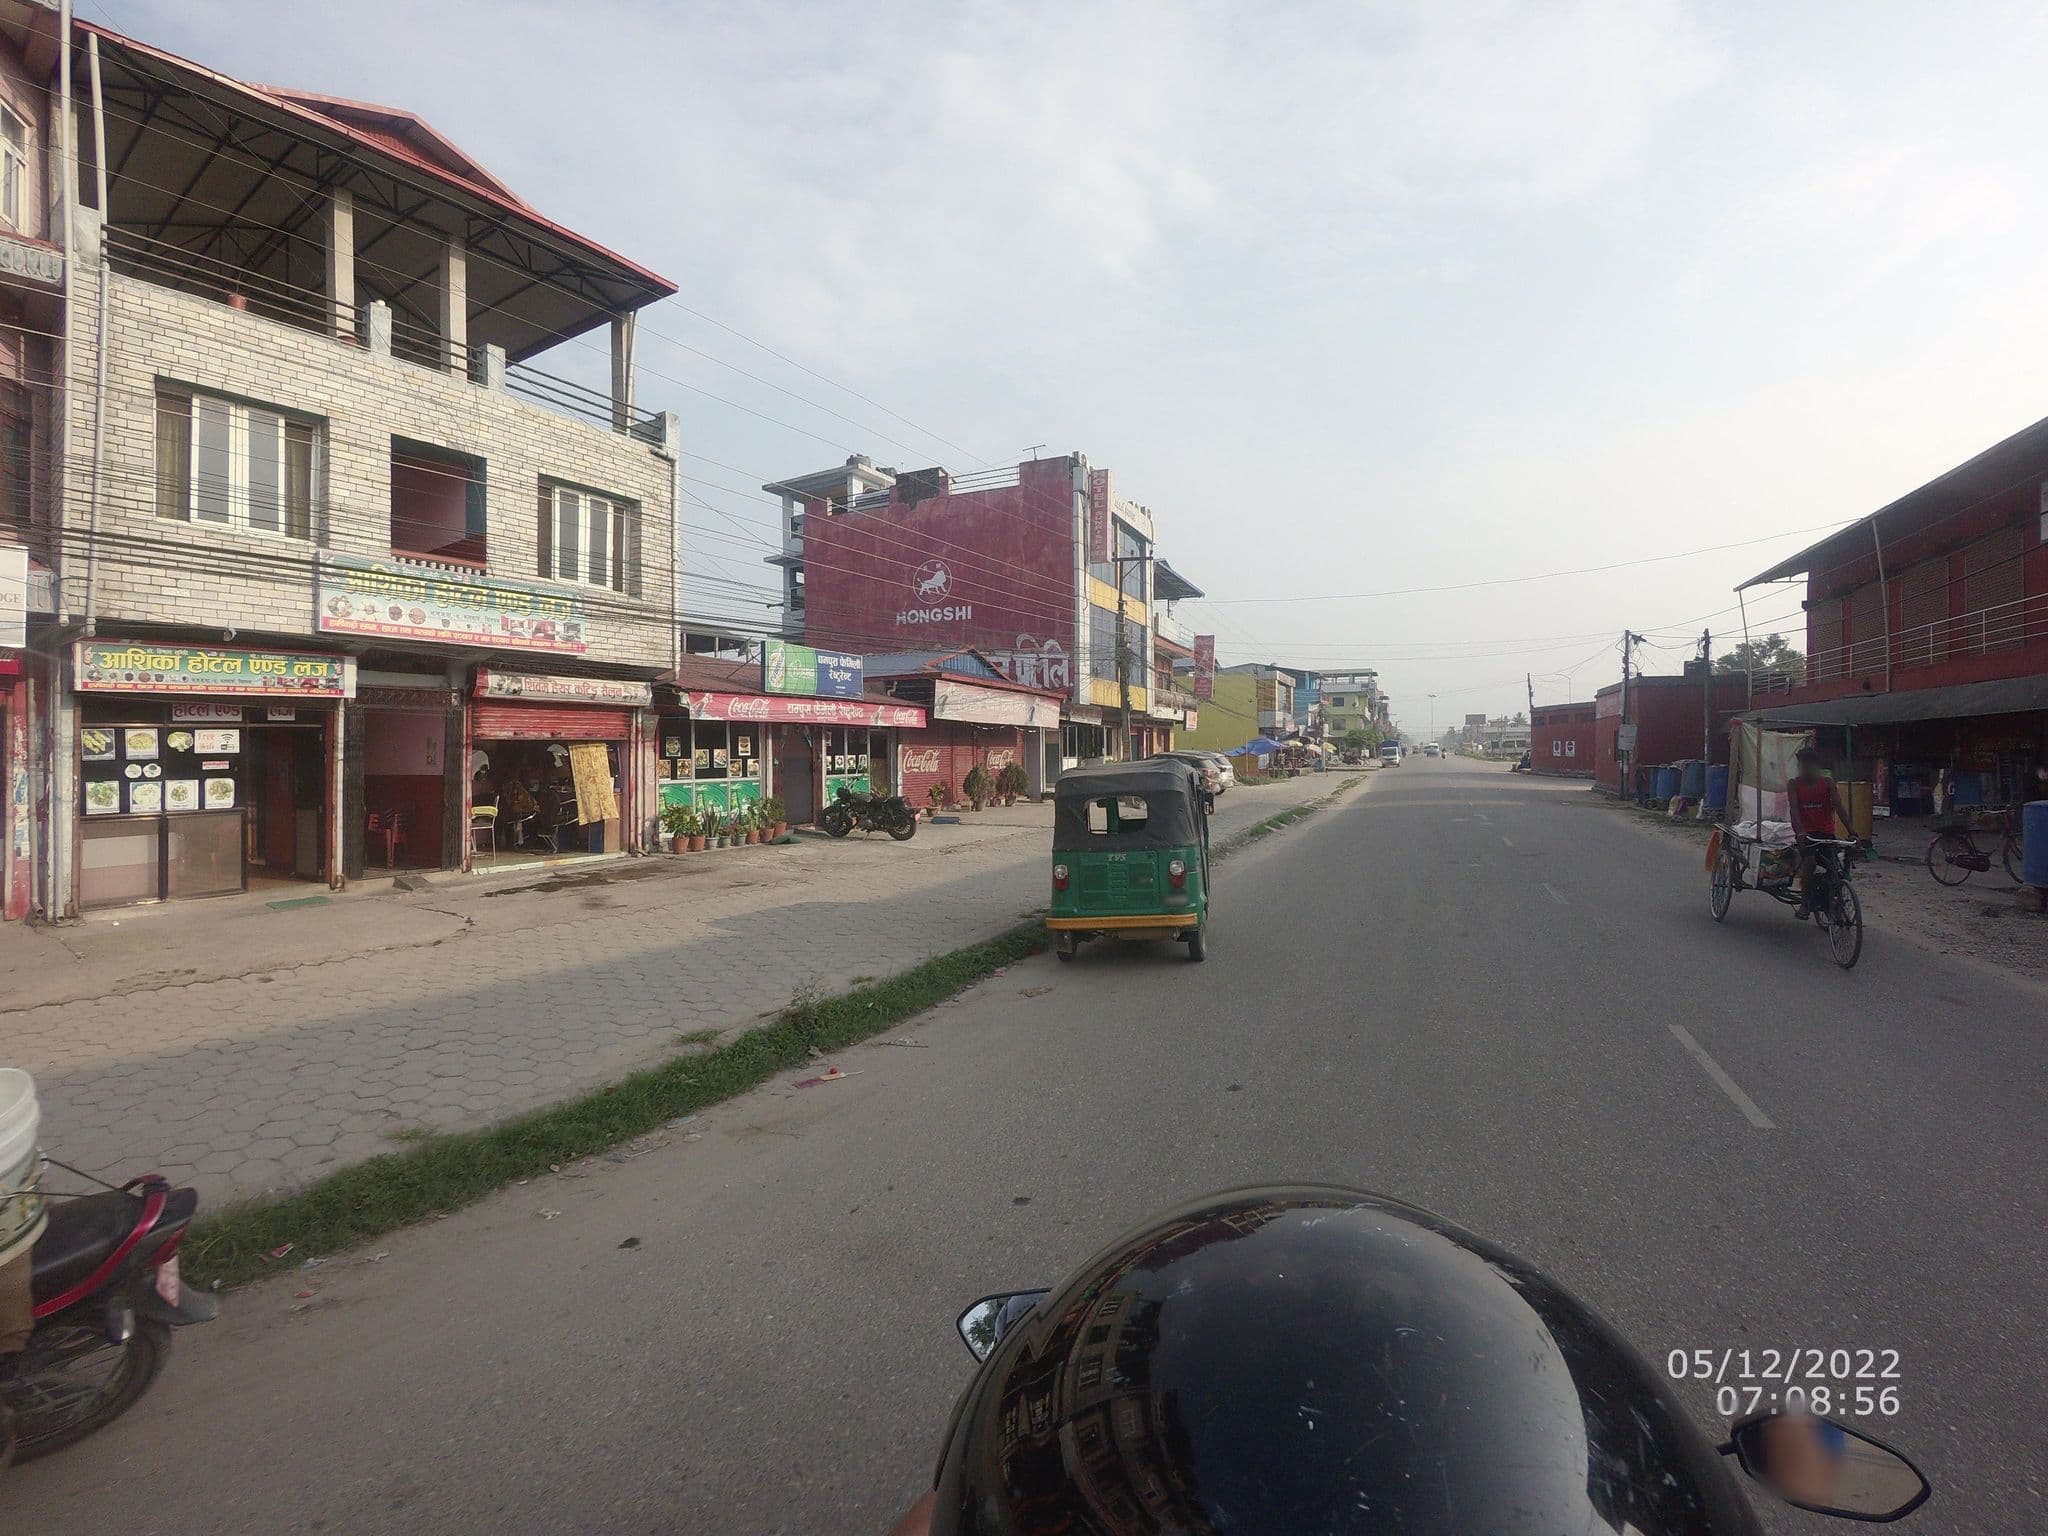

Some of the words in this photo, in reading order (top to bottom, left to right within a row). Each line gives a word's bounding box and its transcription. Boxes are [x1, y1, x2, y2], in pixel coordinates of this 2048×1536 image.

[0, 593, 21, 604] GE
[896, 606, 972, 625] HONGSHI
[98, 647, 182, 671] आशिका
[187, 651, 243, 674] होटल
[250, 659, 289, 676] एण्ड
[293, 661, 329, 678] लज
